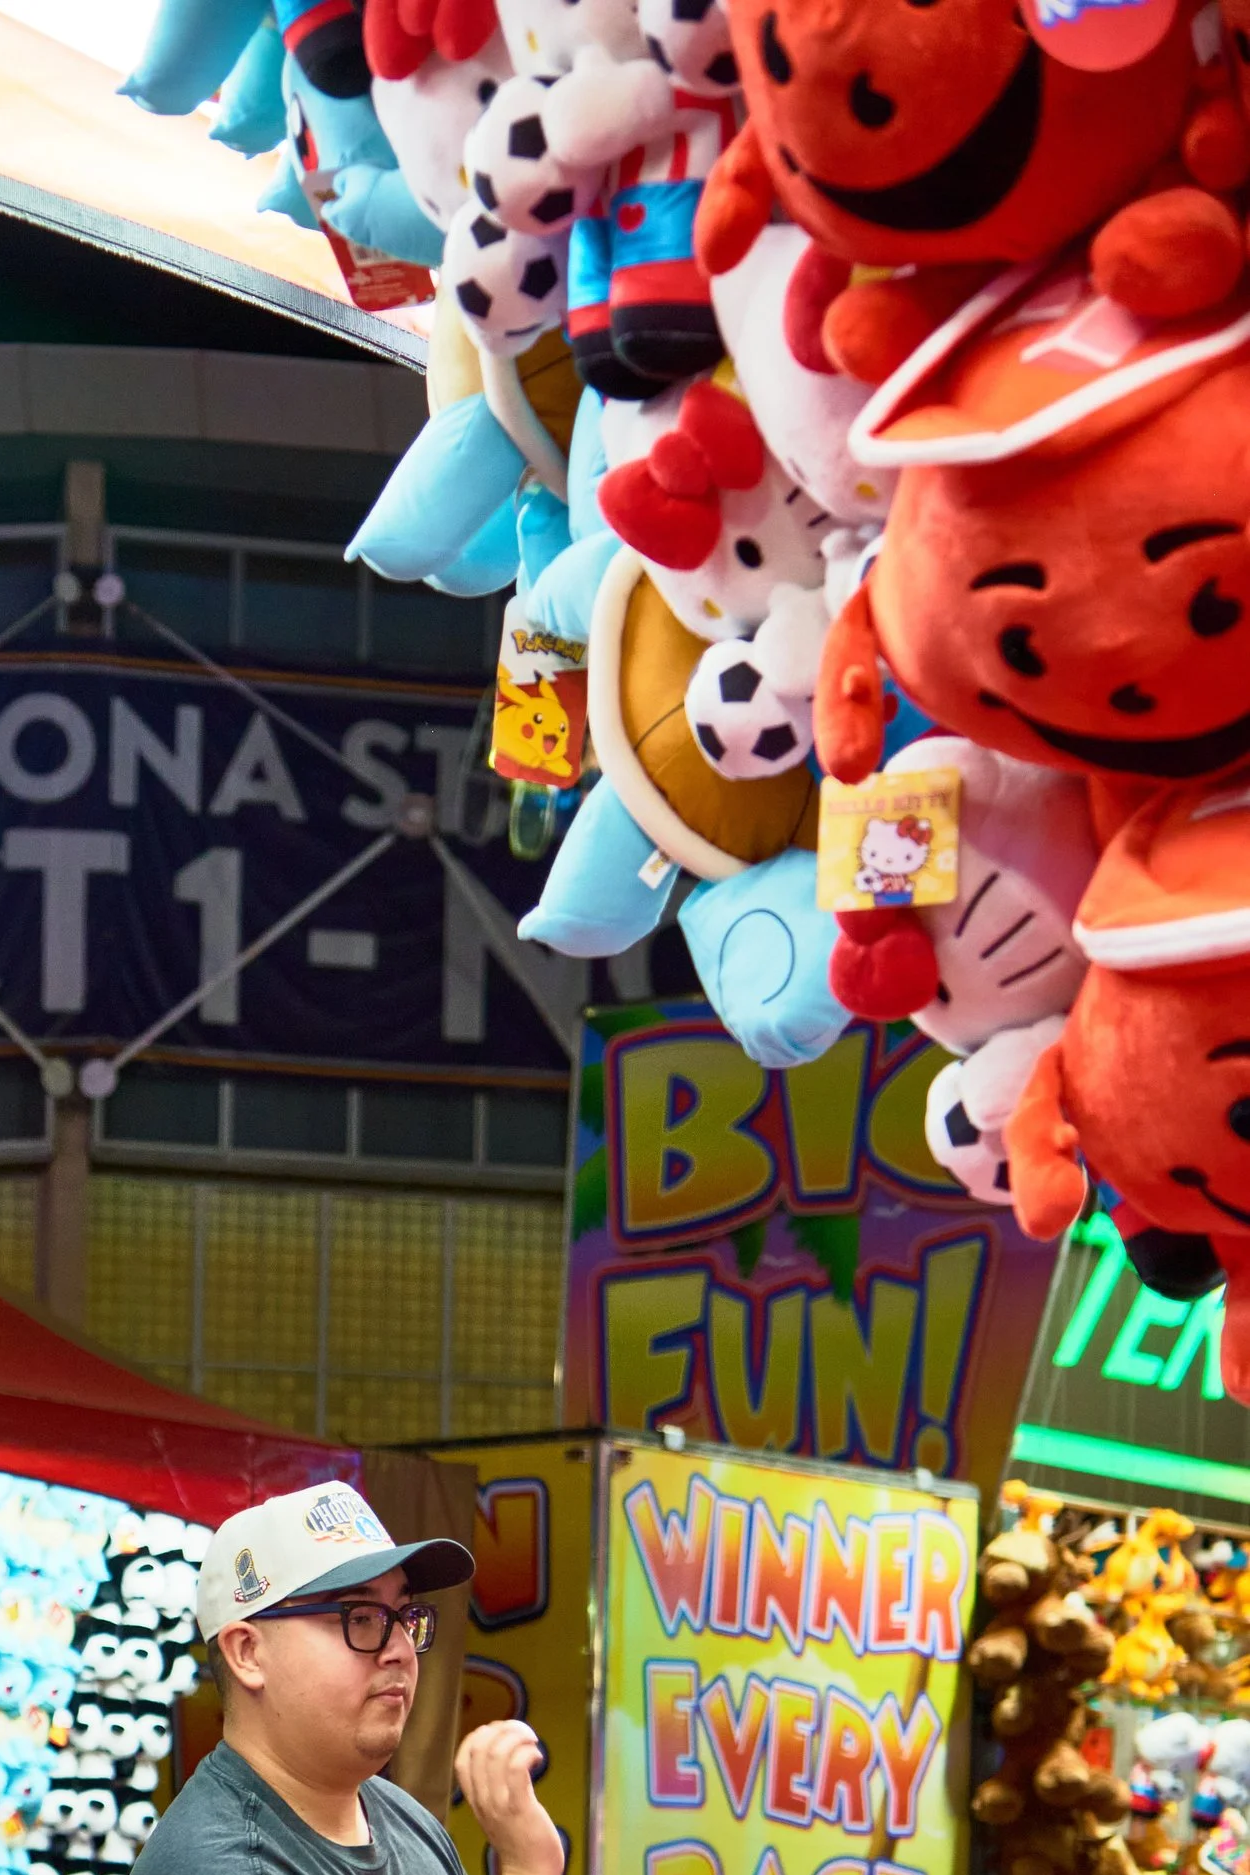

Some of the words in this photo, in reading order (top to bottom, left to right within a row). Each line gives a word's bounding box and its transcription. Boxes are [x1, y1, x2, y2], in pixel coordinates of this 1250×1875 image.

[340, 718, 495, 834] ST
[174, 847, 241, 1024] 1
[601, 1238, 987, 1475] FUN!
[625, 1474, 969, 1661] WINNER
[645, 1659, 941, 1837] EVERY
